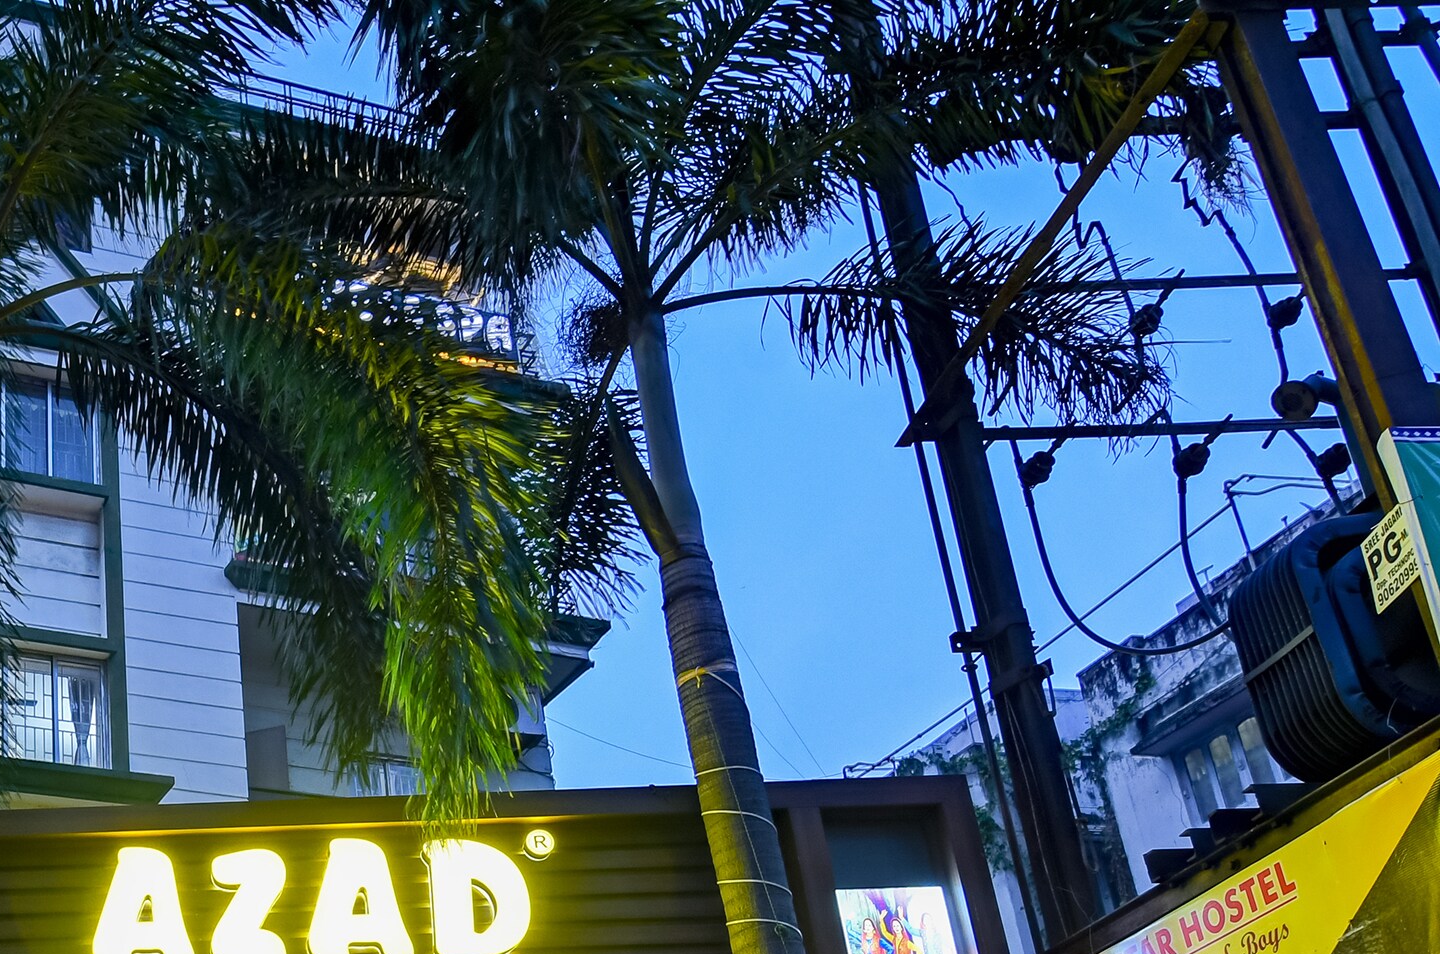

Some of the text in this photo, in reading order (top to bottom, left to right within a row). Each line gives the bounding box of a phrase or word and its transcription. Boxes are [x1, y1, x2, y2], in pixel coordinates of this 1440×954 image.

[1364, 507, 1403, 554] SREE JAGAN
[1368, 531, 1402, 581] PG
[1179, 862, 1297, 948] HOSTEL
